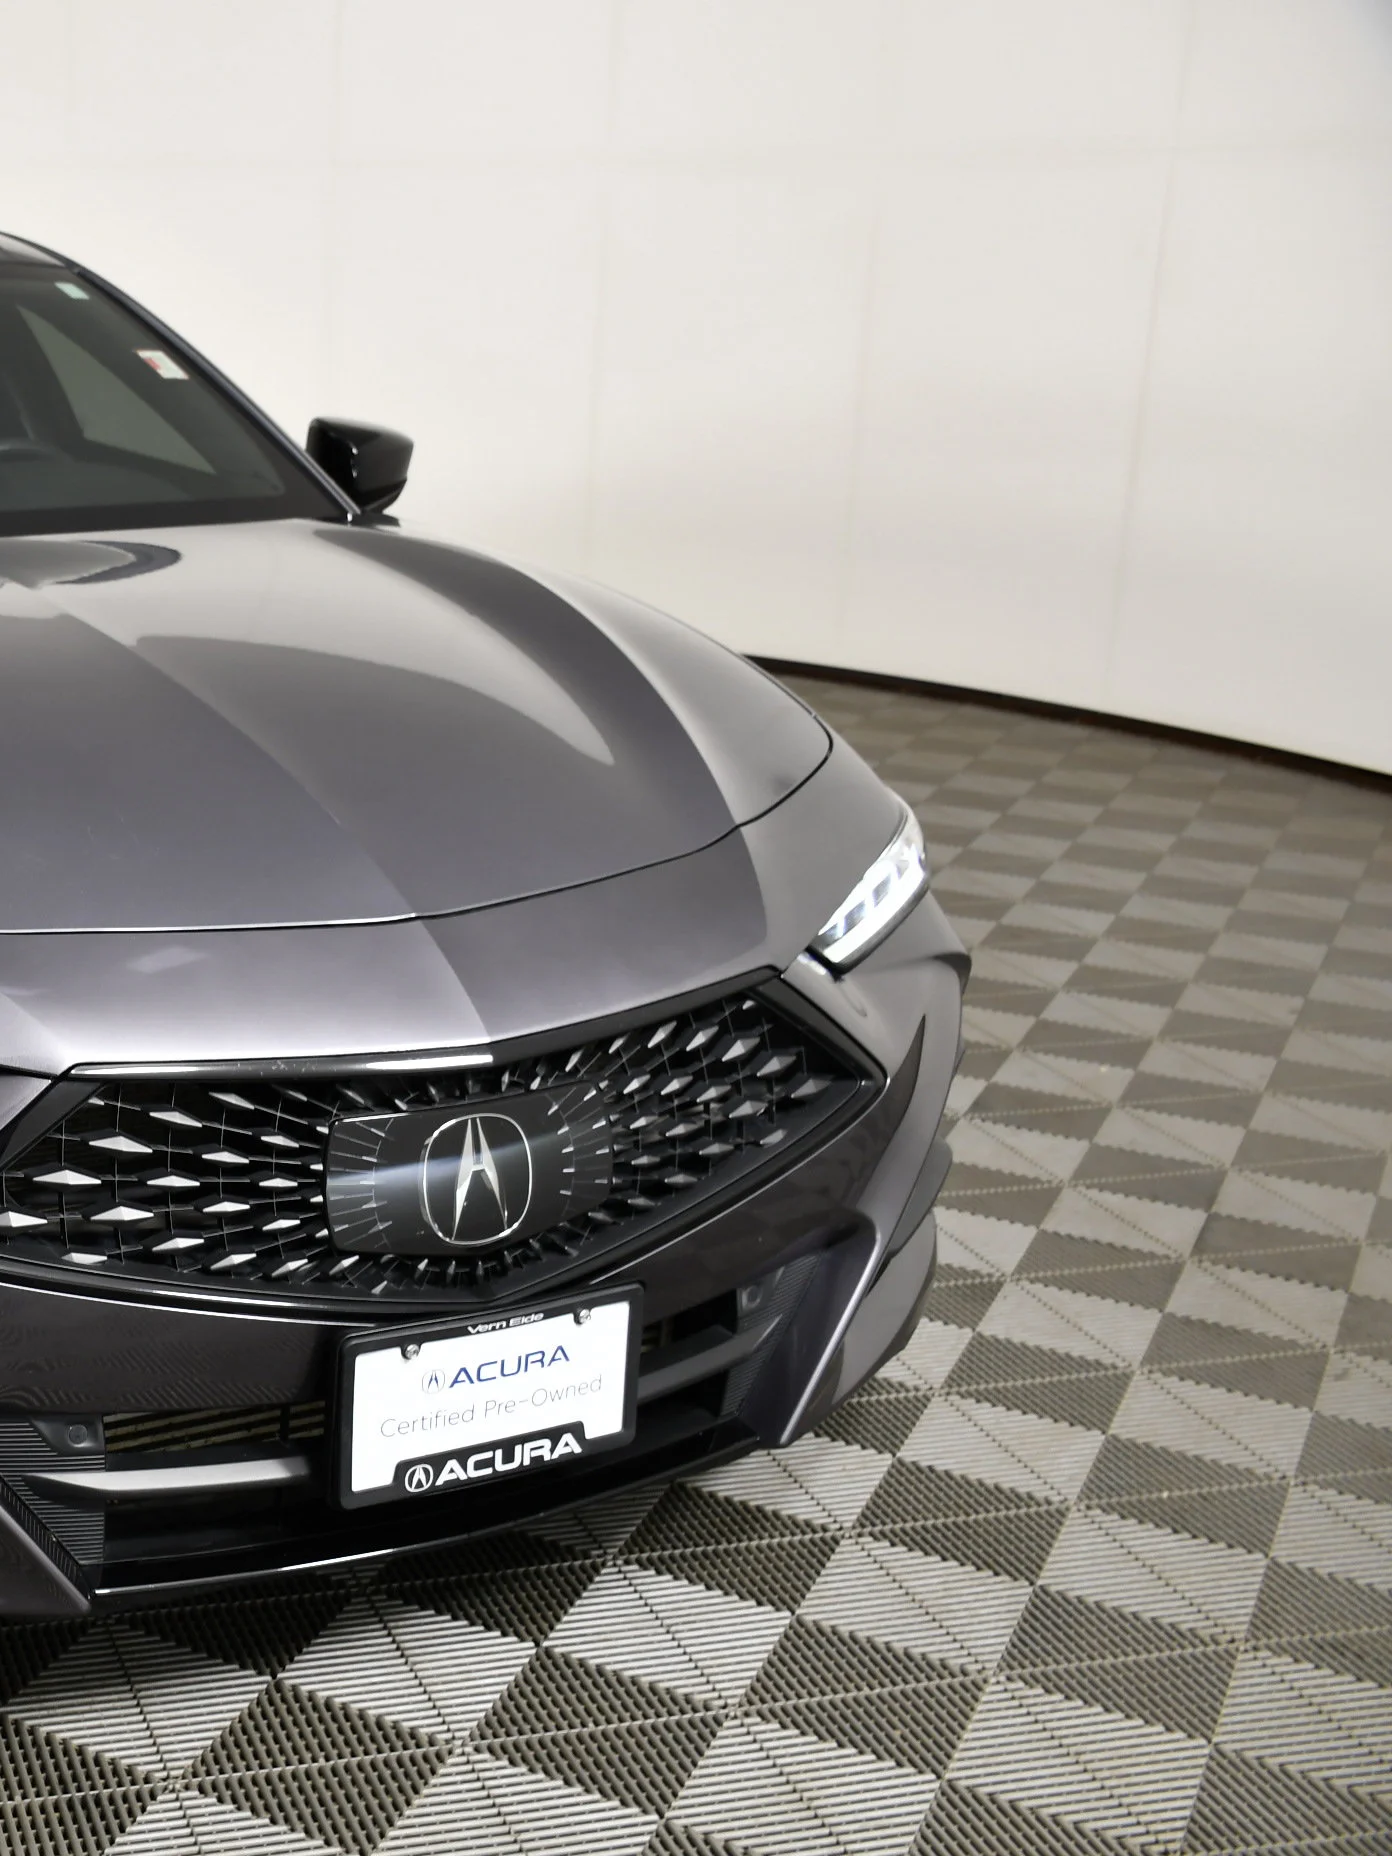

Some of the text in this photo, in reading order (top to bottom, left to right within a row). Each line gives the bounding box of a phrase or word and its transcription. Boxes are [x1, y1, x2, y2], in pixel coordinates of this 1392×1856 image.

[466, 1311, 544, 1334] Vern Eide
[448, 1344, 570, 1389] ACURA
[380, 1374, 602, 1438] Certified Pre-Owned
[435, 1432, 582, 1487] ACURA
